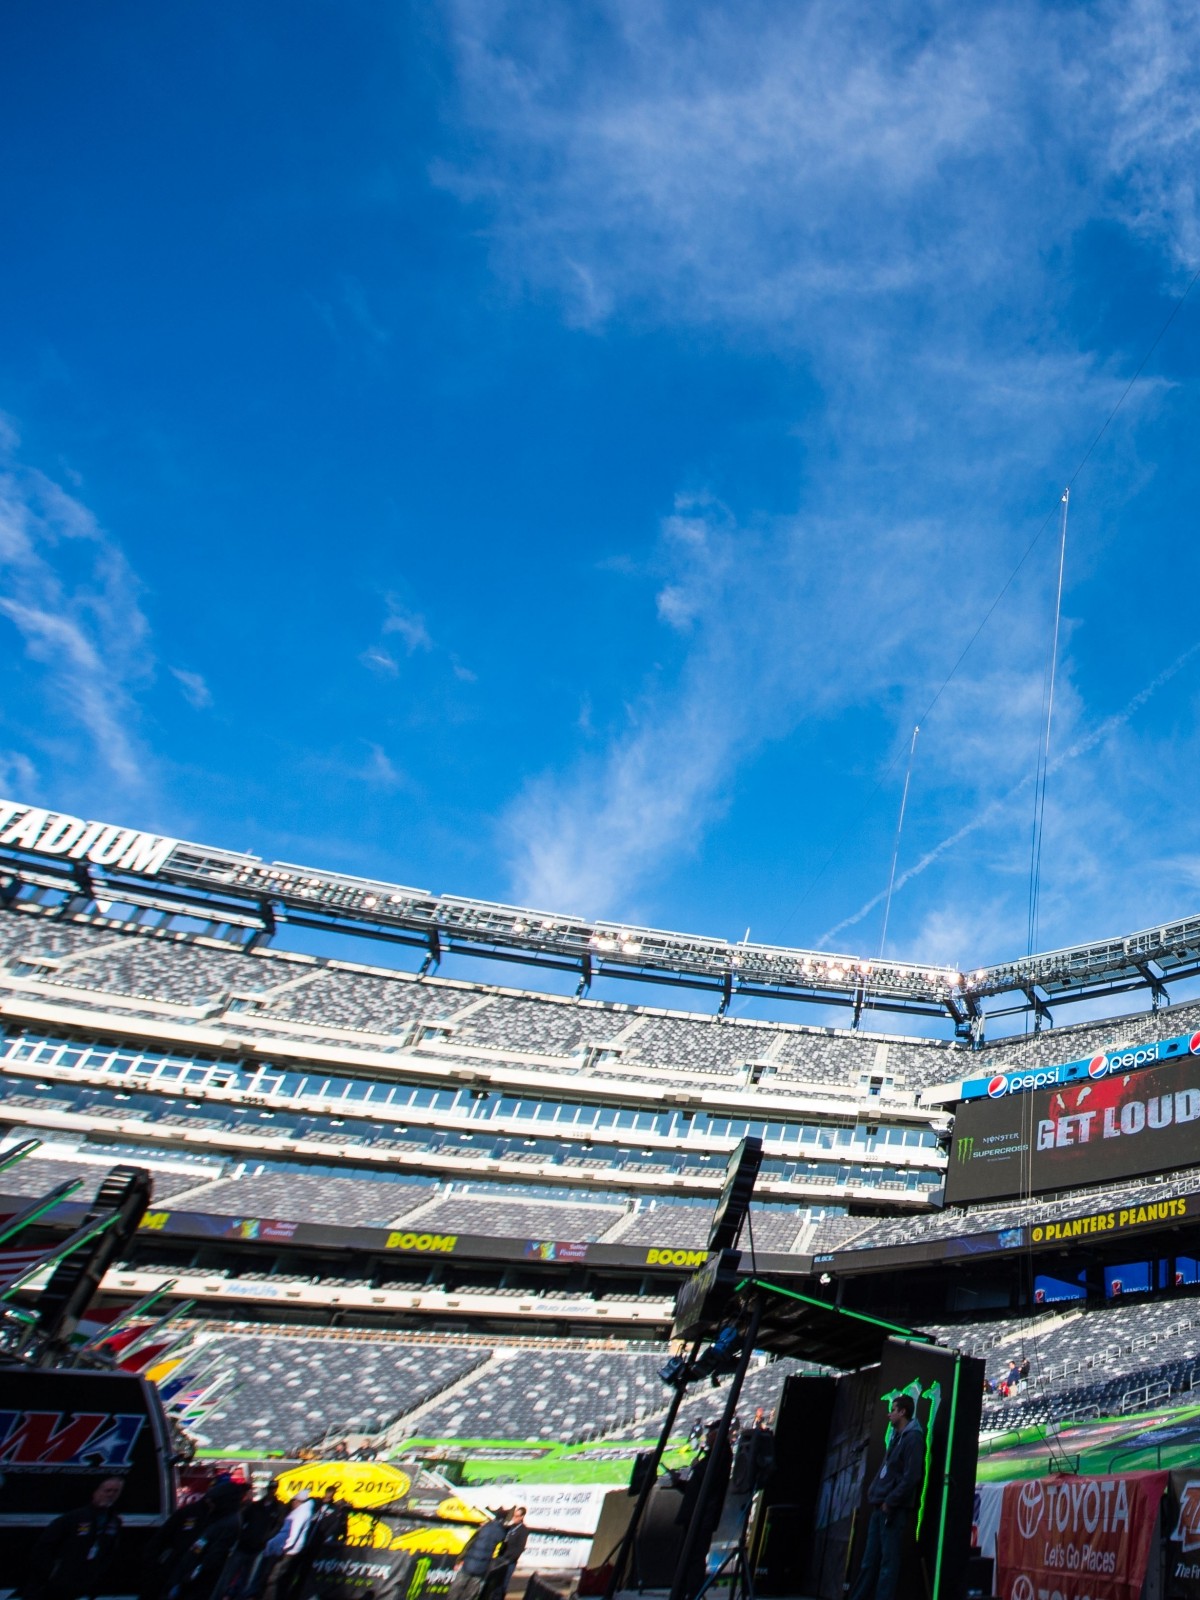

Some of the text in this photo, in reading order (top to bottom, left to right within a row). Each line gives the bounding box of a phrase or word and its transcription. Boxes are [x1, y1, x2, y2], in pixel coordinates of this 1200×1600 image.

[1109, 1044, 1159, 1074] pepsi
[1010, 1067, 1060, 1094] pepsi
[982, 1132, 1020, 1144] MONSTER
[1037, 1111, 1097, 1151] GET
[973, 1144, 1029, 1158] SUPERCROSS
[1045, 1198, 1187, 1241] PLANTERS PEANUTS
[385, 1231, 458, 1252] BOOM!
[227, 1283, 279, 1297] MetLife
[286, 1480, 327, 1492] MAY
[353, 1480, 395, 1494] 2015
[1047, 1480, 1130, 1533] TOYOTA
[1043, 1541, 1116, 1573] Let's Go Places
[1175, 1562, 1190, 1579] The
